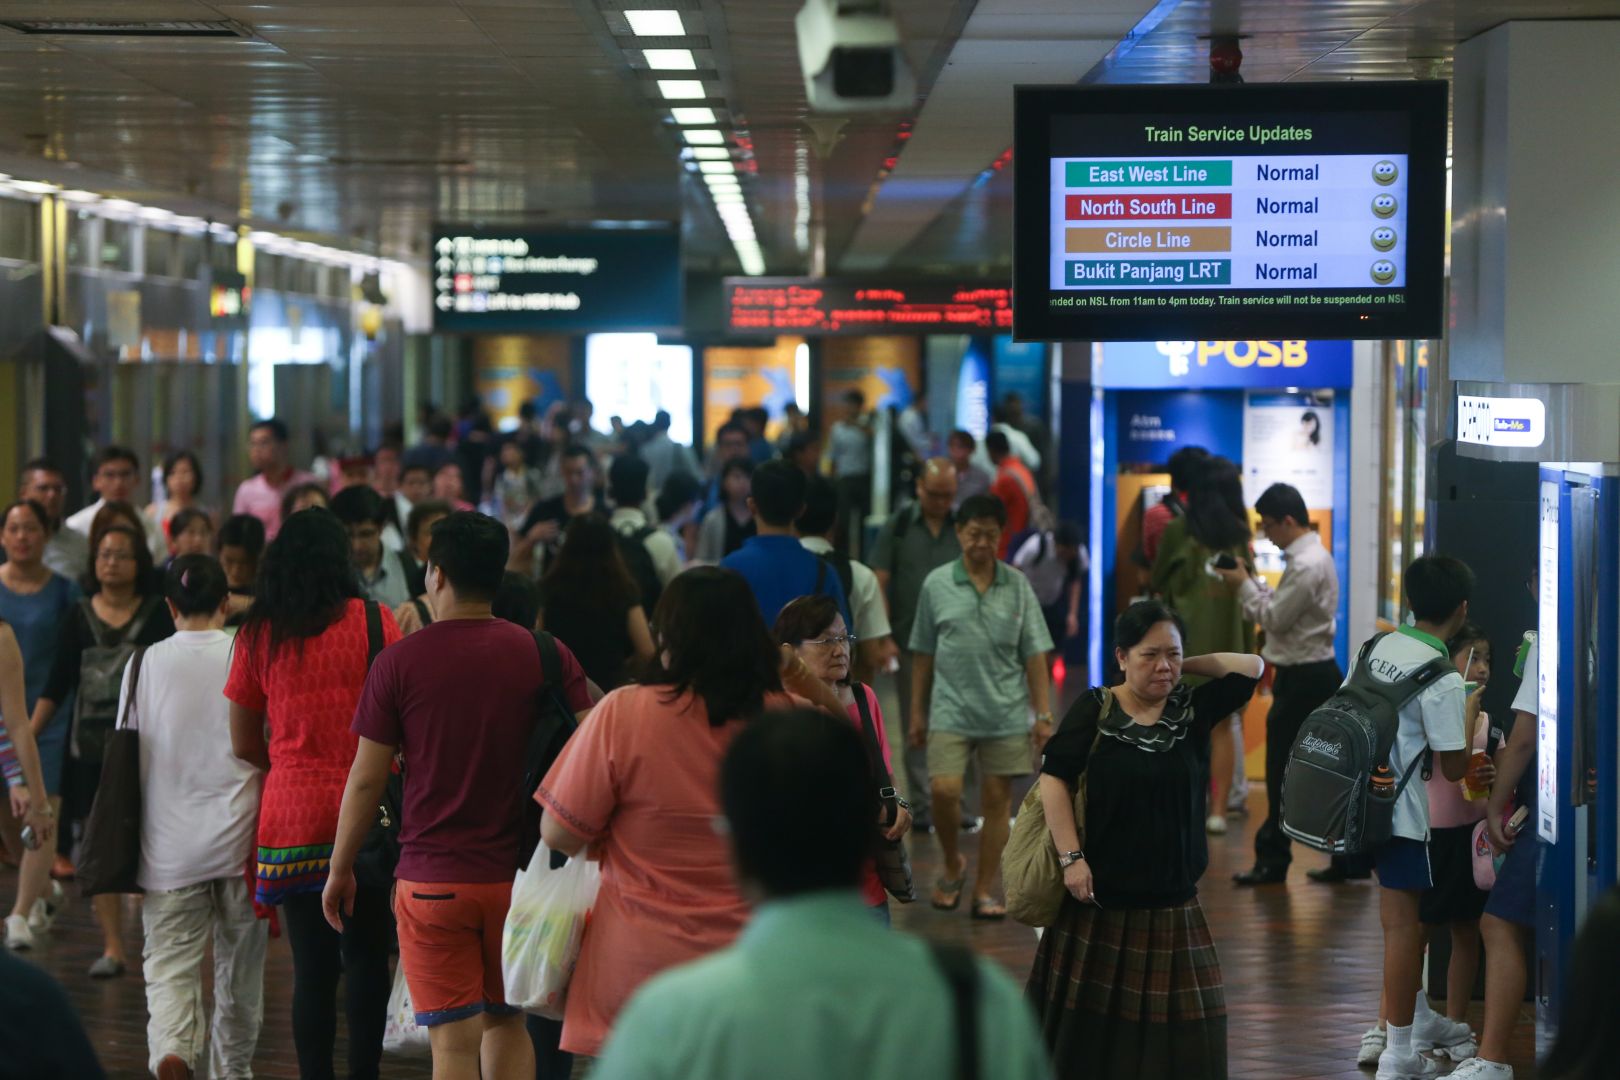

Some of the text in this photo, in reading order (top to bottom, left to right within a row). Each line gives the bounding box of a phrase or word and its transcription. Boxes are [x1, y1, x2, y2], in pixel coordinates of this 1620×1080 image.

[1145, 125, 1313, 144] Train Service Updates
[1089, 165, 1208, 182] East West Line
[1257, 164, 1319, 181] Normal
[1080, 198, 1216, 215] North South Line
[1256, 197, 1319, 214] Normal
[1105, 231, 1191, 248] Circle Line
[1256, 230, 1318, 247] Normal
[1074, 262, 1222, 282] Bukit Panjang LRT
[1255, 263, 1318, 280] Normal
[1075, 298, 1087, 306] on
[1089, 296, 1108, 306] NSL
[1110, 296, 1131, 306] from
[1133, 296, 1156, 306] 11am
[1157, 296, 1167, 306] to
[1168, 296, 1188, 307] 4pm
[1190, 295, 1216, 307] today.
[1218, 295, 1240, 305] Train
[1242, 295, 1275, 305] service
[1276, 295, 1292, 305] will
[1293, 295, 1309, 305] not
[1310, 295, 1322, 304] be
[1323, 294, 1372, 306] suspended
[1374, 296, 1386, 304] on
[1196, 340, 1308, 368] POSB
[1369, 658, 1408, 683] CERI
